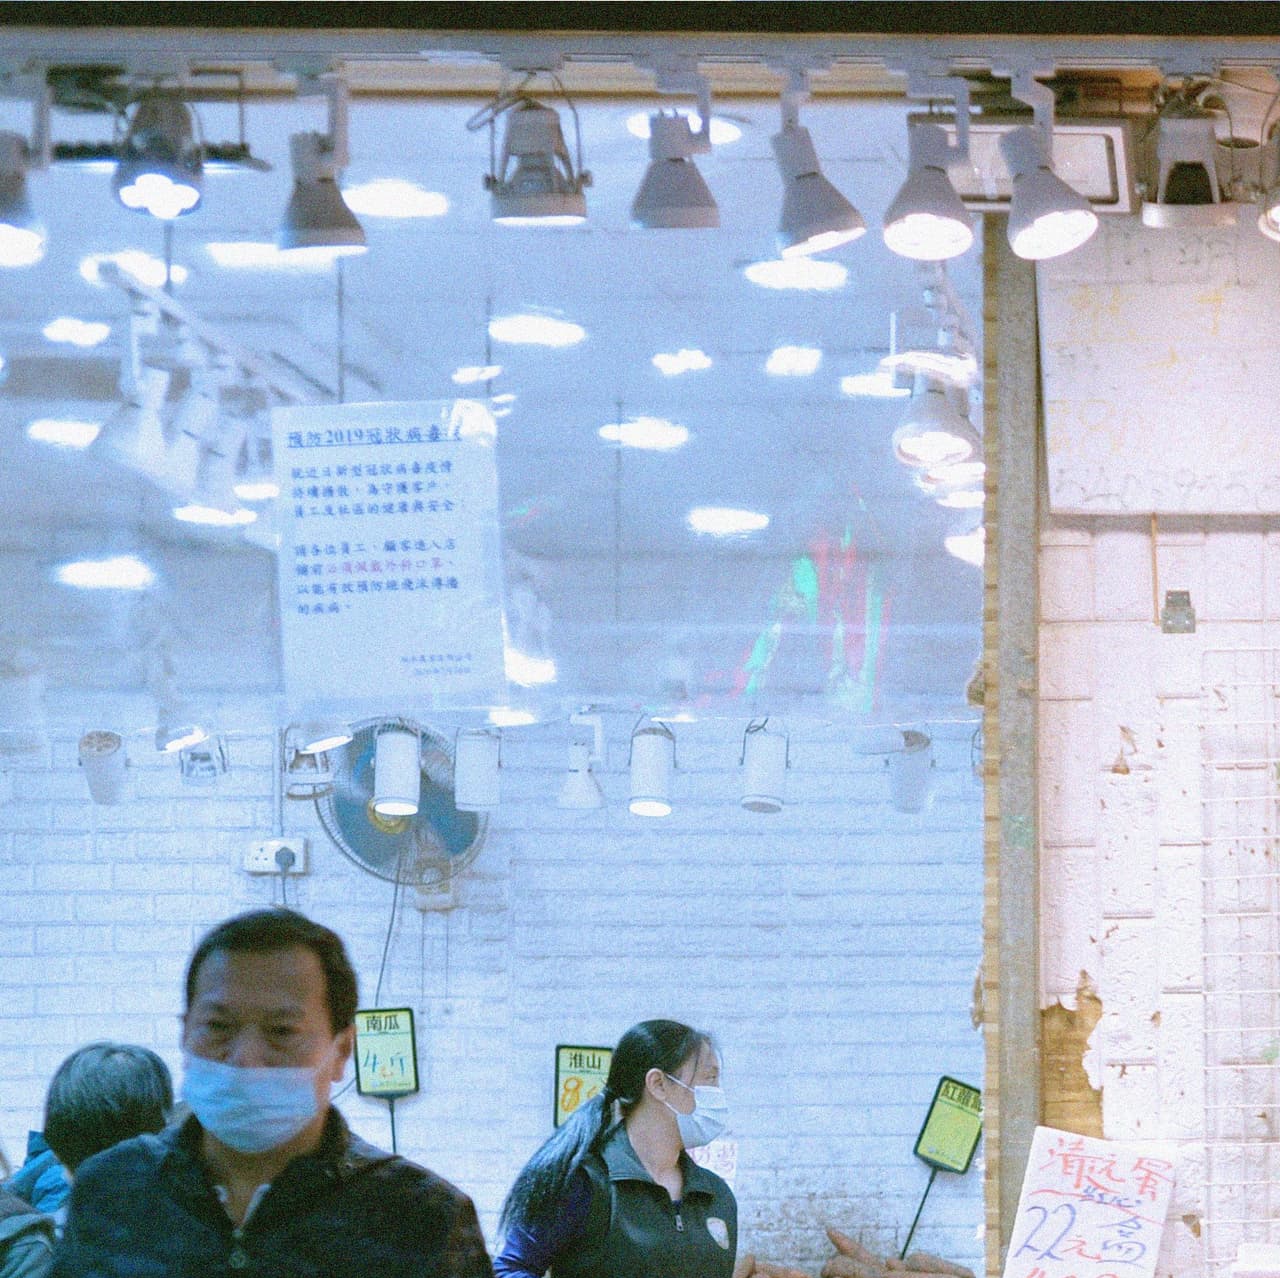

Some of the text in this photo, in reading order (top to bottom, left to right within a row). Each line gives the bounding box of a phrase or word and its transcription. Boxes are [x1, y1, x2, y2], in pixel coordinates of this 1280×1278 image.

[288, 425, 463, 449] 預防2019冠狀病毒
[366, 1015, 400, 1032] 南瓜
[569, 1052, 601, 1069] 淮山
